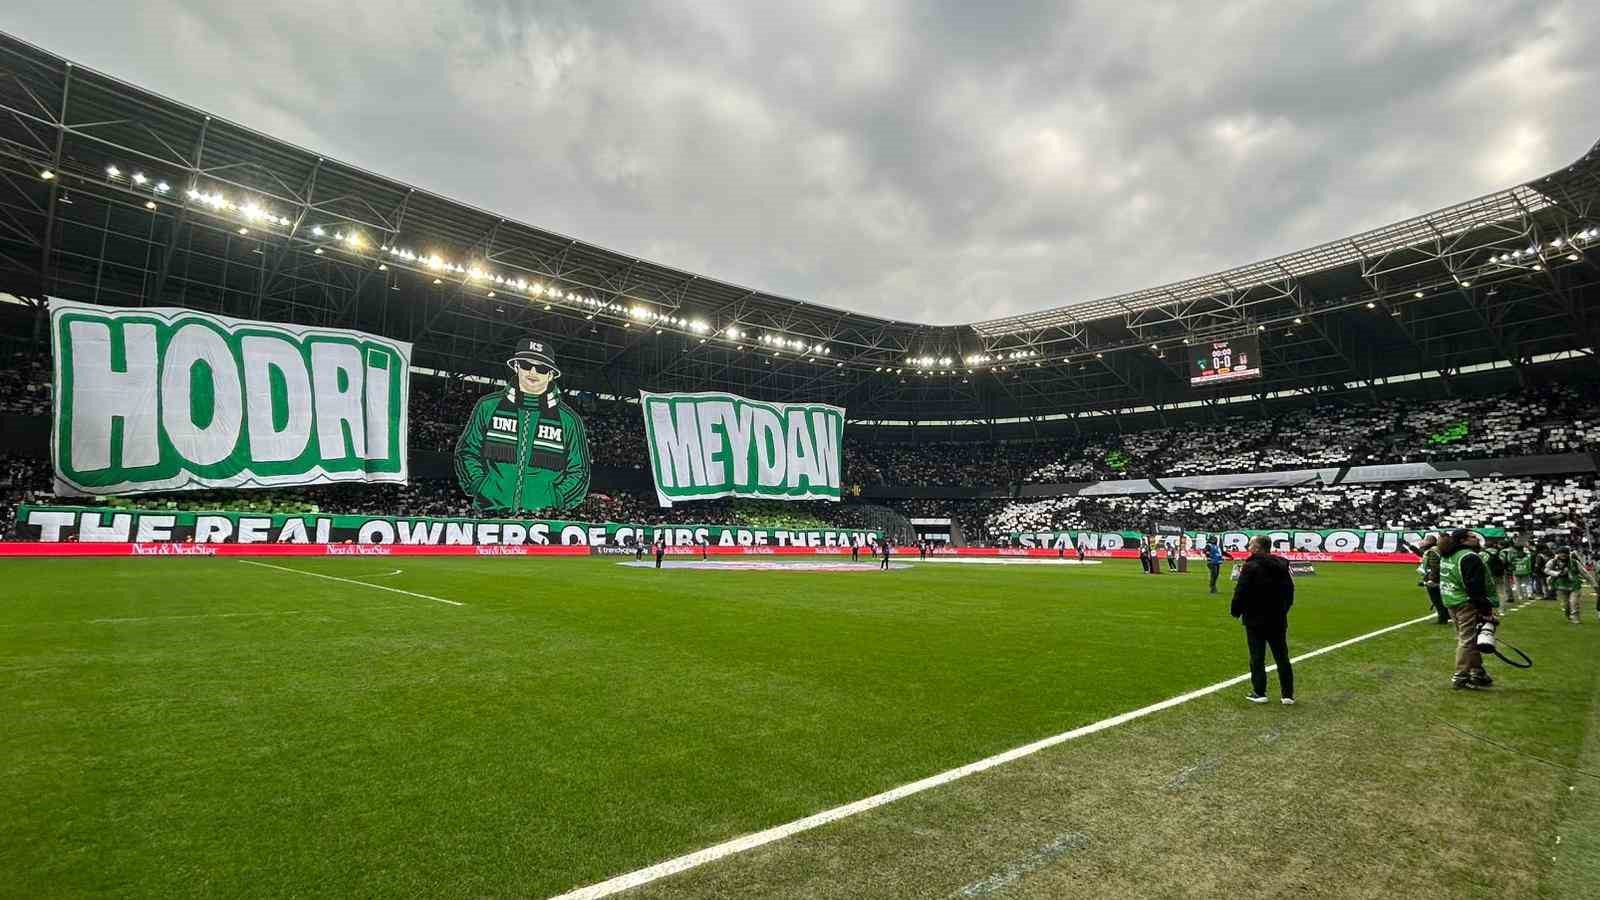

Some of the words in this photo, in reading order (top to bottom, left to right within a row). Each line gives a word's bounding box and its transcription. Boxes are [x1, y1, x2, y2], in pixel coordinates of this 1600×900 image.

[529, 341, 544, 352] KS
[492, 416, 518, 433] UNI
[537, 424, 562, 442] HM
[650, 401, 840, 488] MEYDAN
[28, 511, 176, 543] THE
[194, 515, 332, 544] REAL
[358, 519, 550, 545] OWNERS
[561, 525, 607, 546] OF
[719, 529, 767, 546] ARE
[775, 531, 821, 547] THE
[825, 532, 879, 547] FANS
[131, 543, 159, 555] Next
[160, 544, 169, 554] &
[171, 543, 217, 555] NextStar
[1019, 533, 1124, 550] STAND
